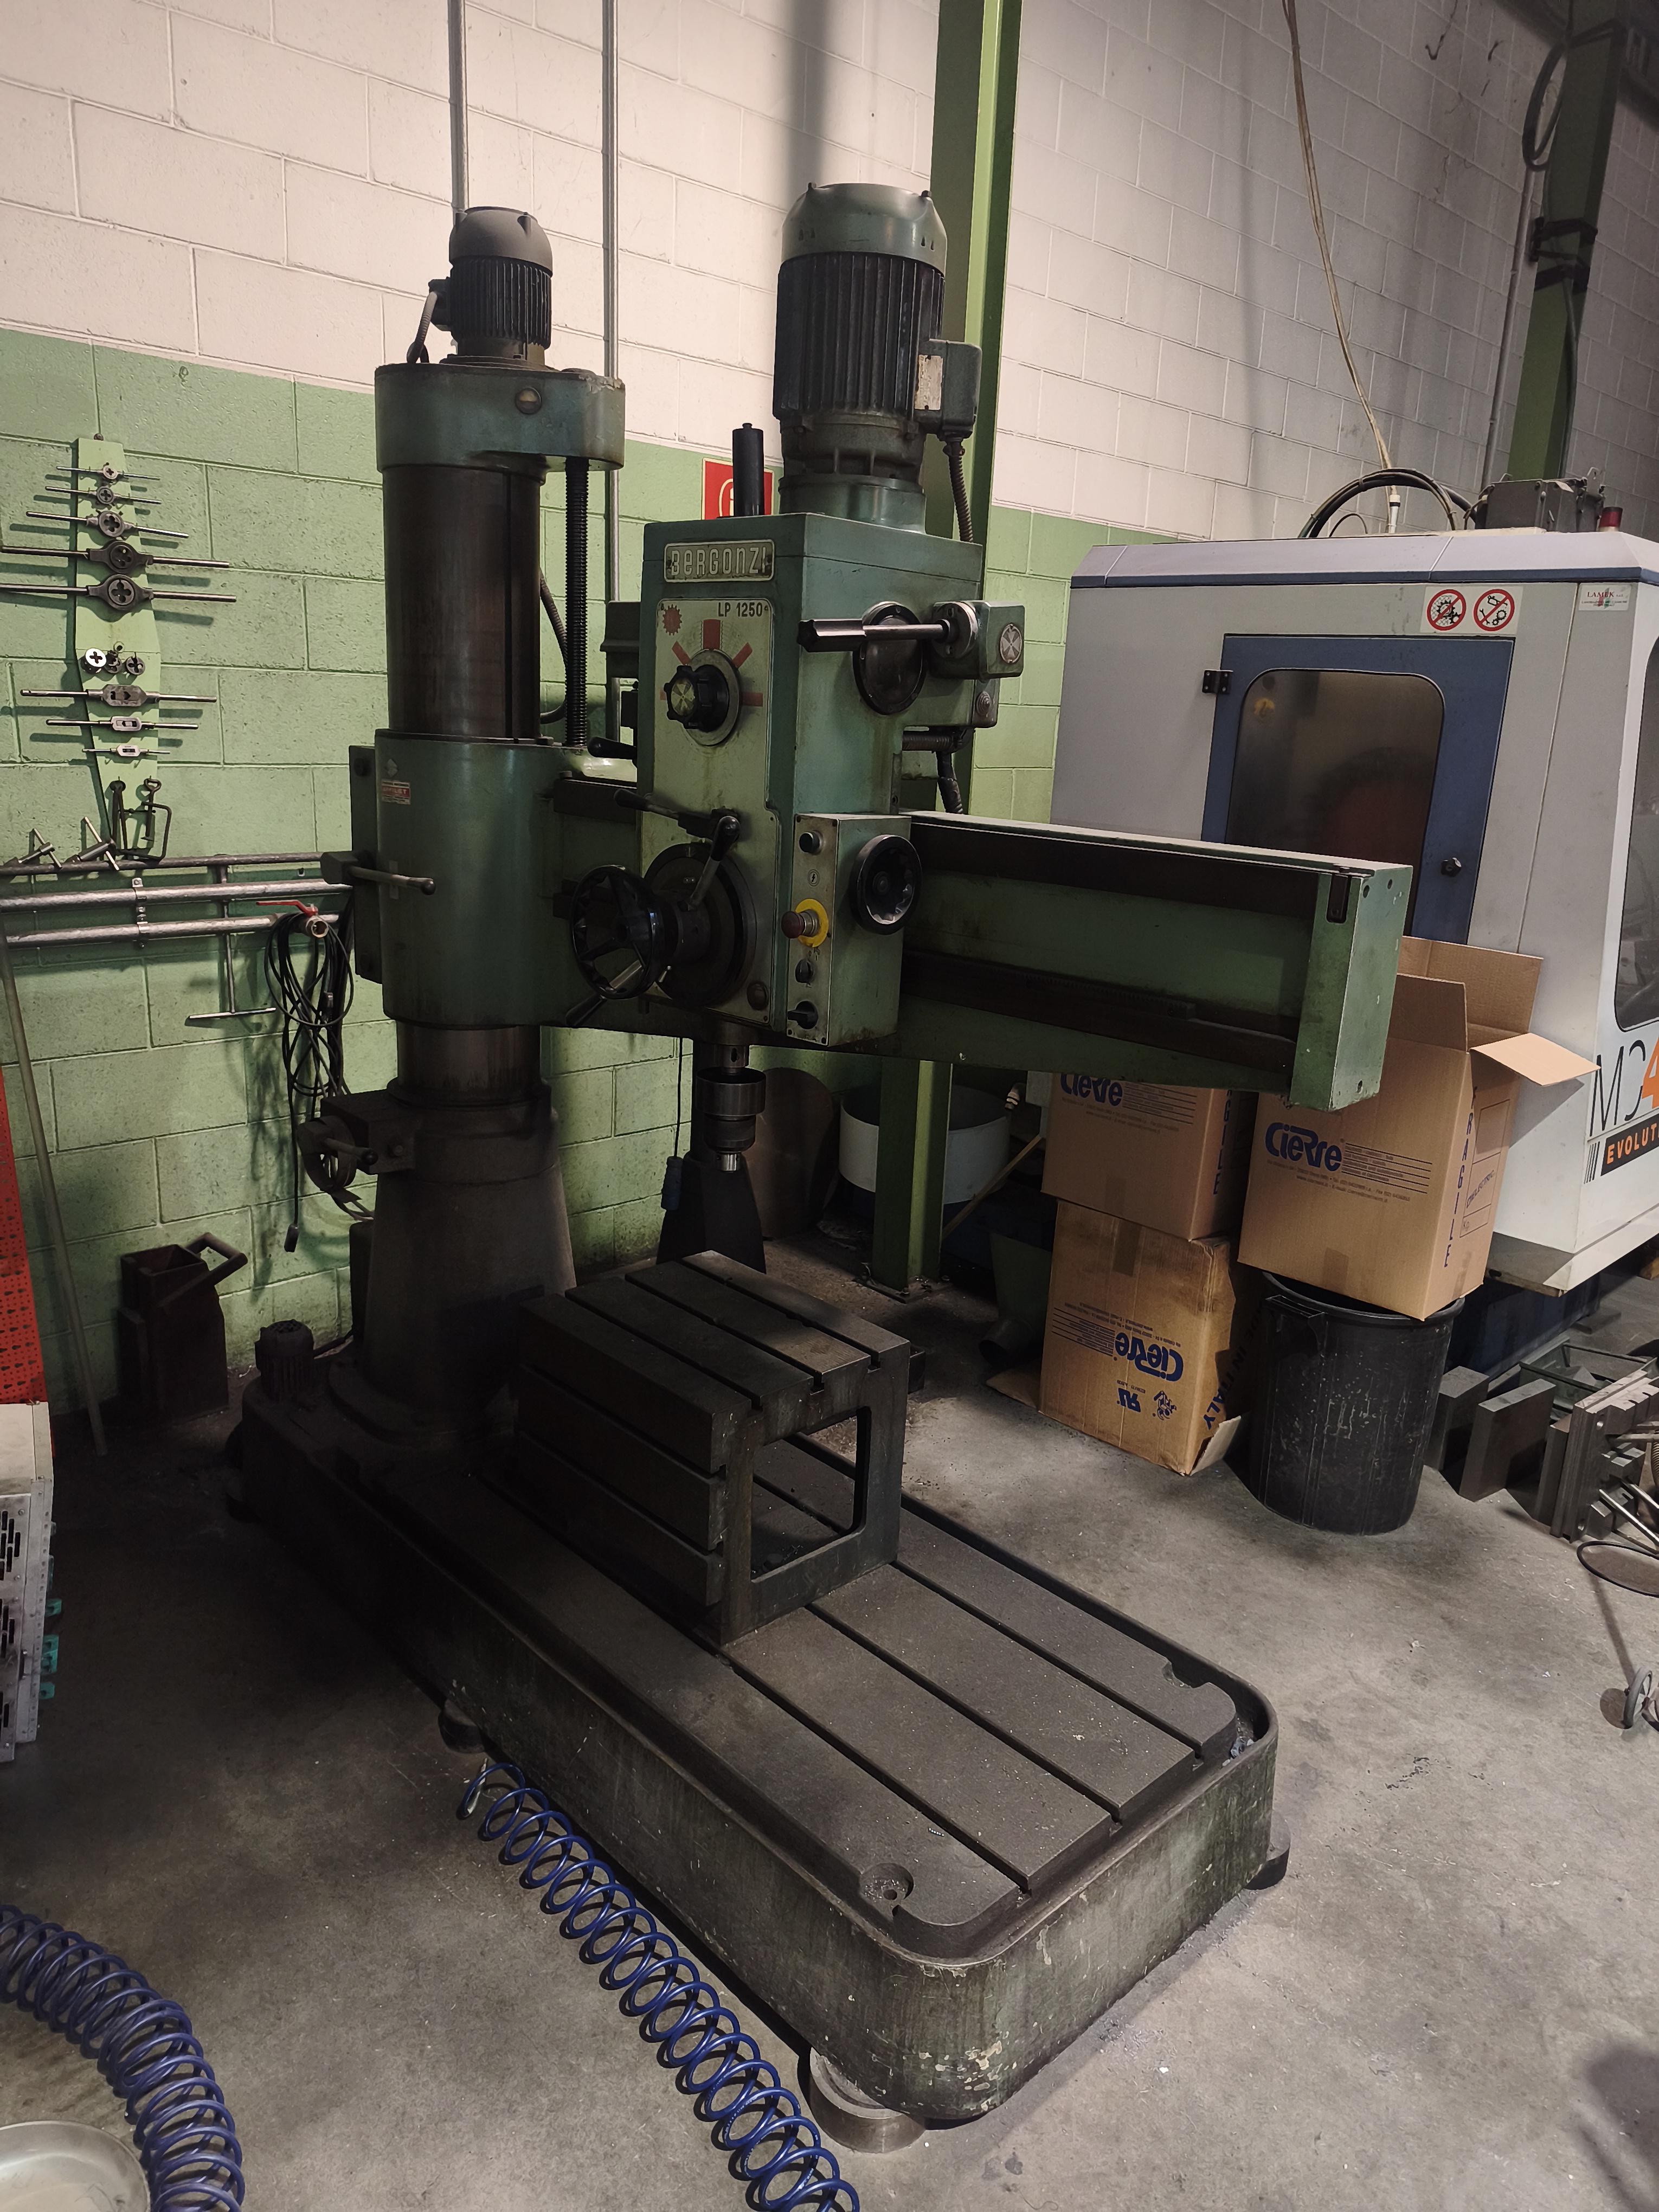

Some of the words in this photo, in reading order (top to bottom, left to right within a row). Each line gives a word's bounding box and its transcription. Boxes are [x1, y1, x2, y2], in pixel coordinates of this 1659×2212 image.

[718, 602, 731, 617] LP
[736, 602, 763, 617] 1250
[1213, 1090, 1232, 1194] GILE
[1444, 1086, 1477, 1268] FRAGILE
[1203, 1371, 1234, 1430] ITALY
